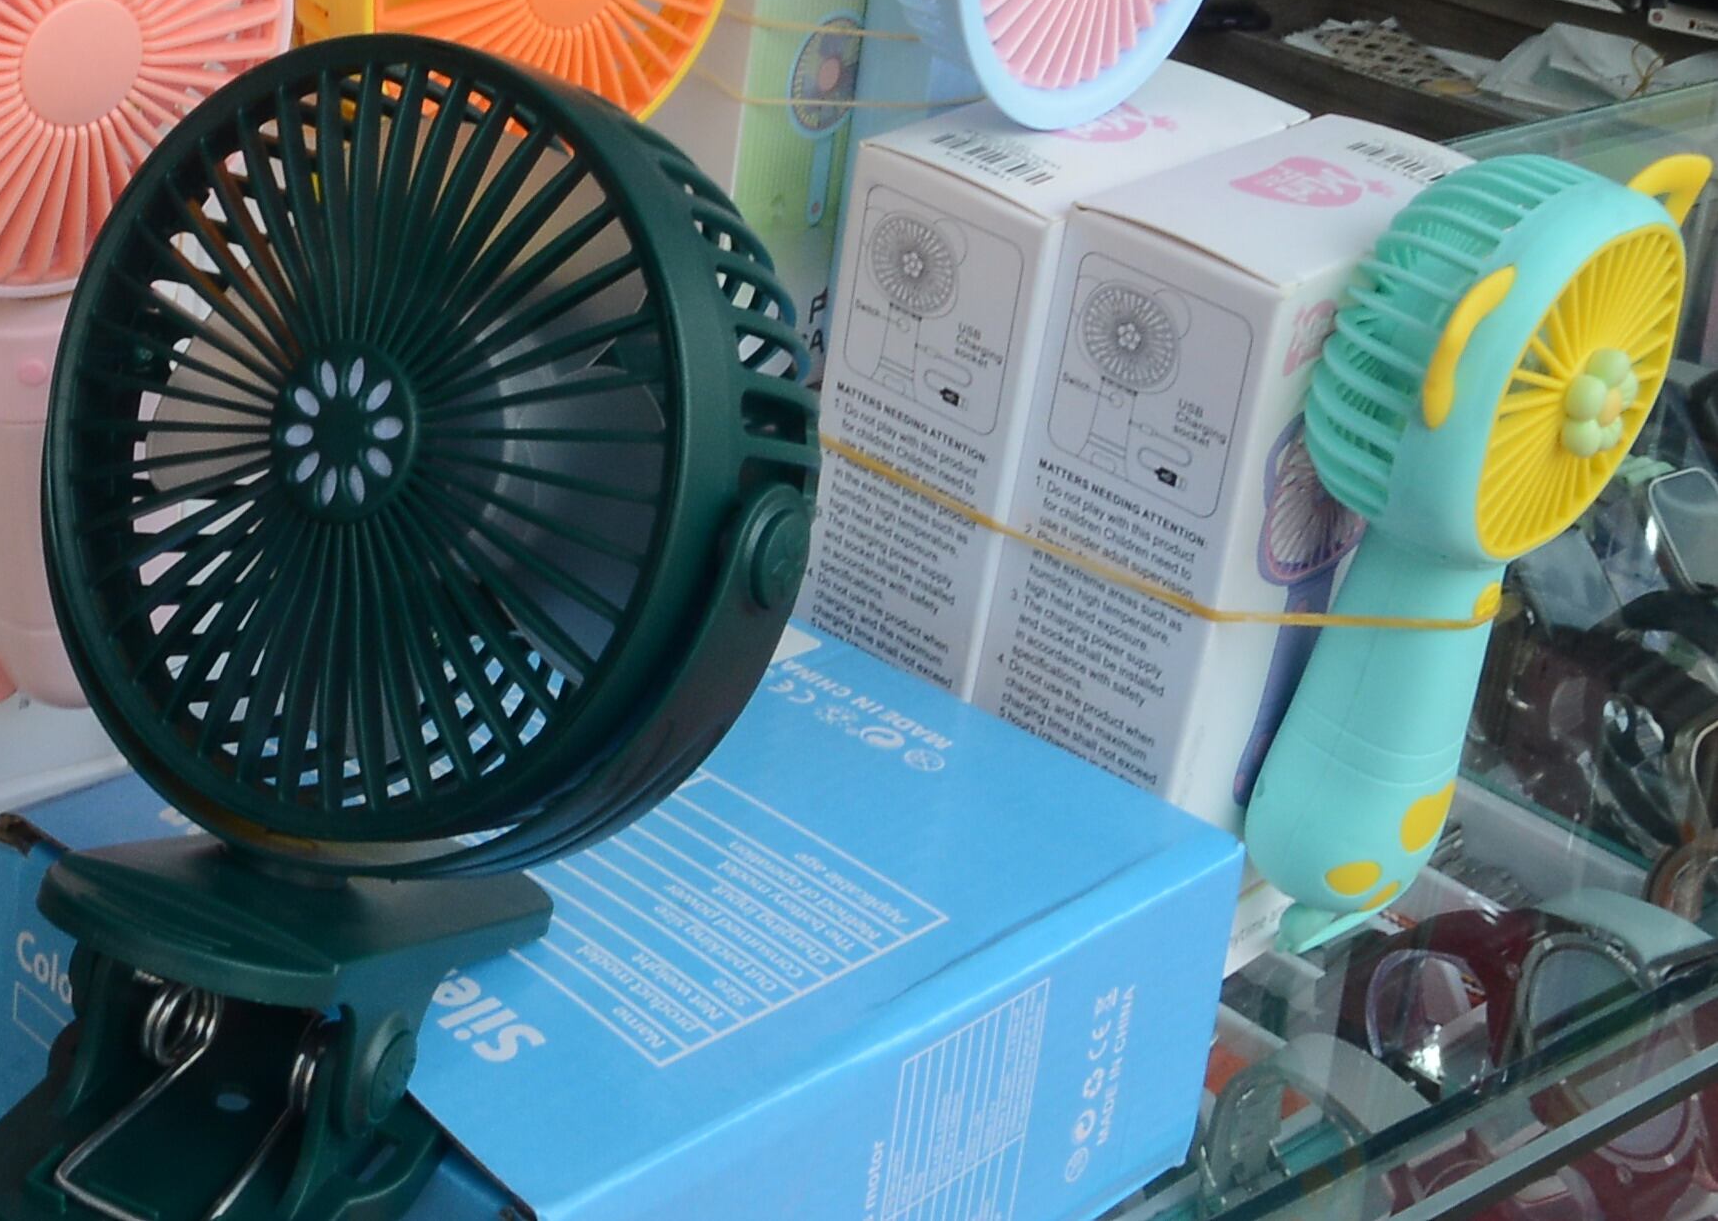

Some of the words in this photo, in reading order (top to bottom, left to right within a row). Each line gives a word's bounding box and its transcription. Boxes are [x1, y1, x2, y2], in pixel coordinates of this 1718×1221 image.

[956, 334, 1004, 365] Charging
[958, 323, 981, 340] USB
[954, 348, 988, 368] socket
[836, 381, 882, 410] MATTERS
[883, 401, 929, 434] NEEDING
[1176, 411, 1228, 445] Charging
[1178, 398, 1204, 418] USB
[1173, 425, 1210, 448] socket
[939, 452, 978, 481] product
[1038, 457, 1089, 489] MATTERS
[1090, 484, 1141, 515] NEEDING
[1039, 516, 1059, 530] use
[1068, 531, 1101, 552] under
[1102, 546, 1130, 567] adult
[1043, 497, 1058, 512] for
[1059, 505, 1101, 534] children
[1103, 527, 1149, 559] Children
[1150, 552, 1179, 573] need
[1180, 566, 1192, 581] to
[1046, 480, 1062, 497] Do
[1063, 491, 1082, 507] not
[1082, 498, 1106, 521] play
[1106, 512, 1130, 530] with
[1131, 524, 1151, 543] this
[1151, 536, 1196, 565] product
[1025, 580, 1049, 599] high
[1050, 592, 1073, 612] heat
[1074, 606, 1096, 624] and
[1044, 554, 1062, 570] the
[1062, 561, 1106, 593] extreme
[1107, 585, 1139, 609] areas
[1140, 600, 1167, 624] such
[1169, 619, 1183, 633] as
[1076, 588, 1101, 609] high
[1019, 614, 1039, 630] and
[1039, 622, 1075, 647] socket
[1075, 642, 1102, 662] shall
[1103, 656, 1117, 672] be
[1118, 667, 1165, 698] installed
[1024, 595, 1043, 614] The
[1044, 609, 1090, 642] charging
[1090, 634, 1126, 657] power
[1126, 650, 1162, 680] supply
[780, 660, 853, 697] CHINA
[1026, 635, 1087, 675] accordance
[1087, 669, 1111, 688] with
[1111, 682, 1146, 708] safety
[850, 696, 885, 715] IN
[1009, 659, 1024, 676] Do
[1025, 670, 1043, 686] not
[1044, 682, 1063, 697] use
[1064, 690, 1082, 707] the
[1082, 701, 1125, 730] product
[1125, 722, 1155, 747] when
[877, 709, 953, 750] MADE
[1001, 692, 1046, 725] charging
[1046, 715, 1071, 737] time
[1071, 731, 1098, 751] shall
[1098, 745, 1116, 762] not
[1117, 757, 1157, 786] exceed
[1054, 703, 1075, 720] and
[1076, 713, 1094, 731] the
[1094, 726, 1147, 762] maximum
[716, 860, 772, 895] model
[727, 840, 804, 891] operation
[793, 850, 828, 873] age
[661, 883, 723, 924] power
[710, 883, 760, 916] input
[825, 866, 910, 926] Applicable
[653, 904, 687, 935] size
[754, 908, 831, 967] Charging
[827, 903, 882, 941] Method
[827, 928, 856, 952] The
[574, 944, 631, 986] model
[684, 921, 747, 975] packing
[722, 914, 804, 979] Consumed
[630, 952, 692, 1000] weight
[711, 977, 751, 1008] Size
[746, 966, 778, 993] Out
[431, 967, 547, 1063] Sile
[612, 1005, 667, 1050] Name
[631, 980, 699, 1034] product
[691, 996, 724, 1021] Net
[1114, 985, 1136, 1054] CHINA
[1109, 1057, 1123, 1080] IN
[1097, 1082, 1118, 1146] MADE
[865, 1141, 885, 1211] motor
